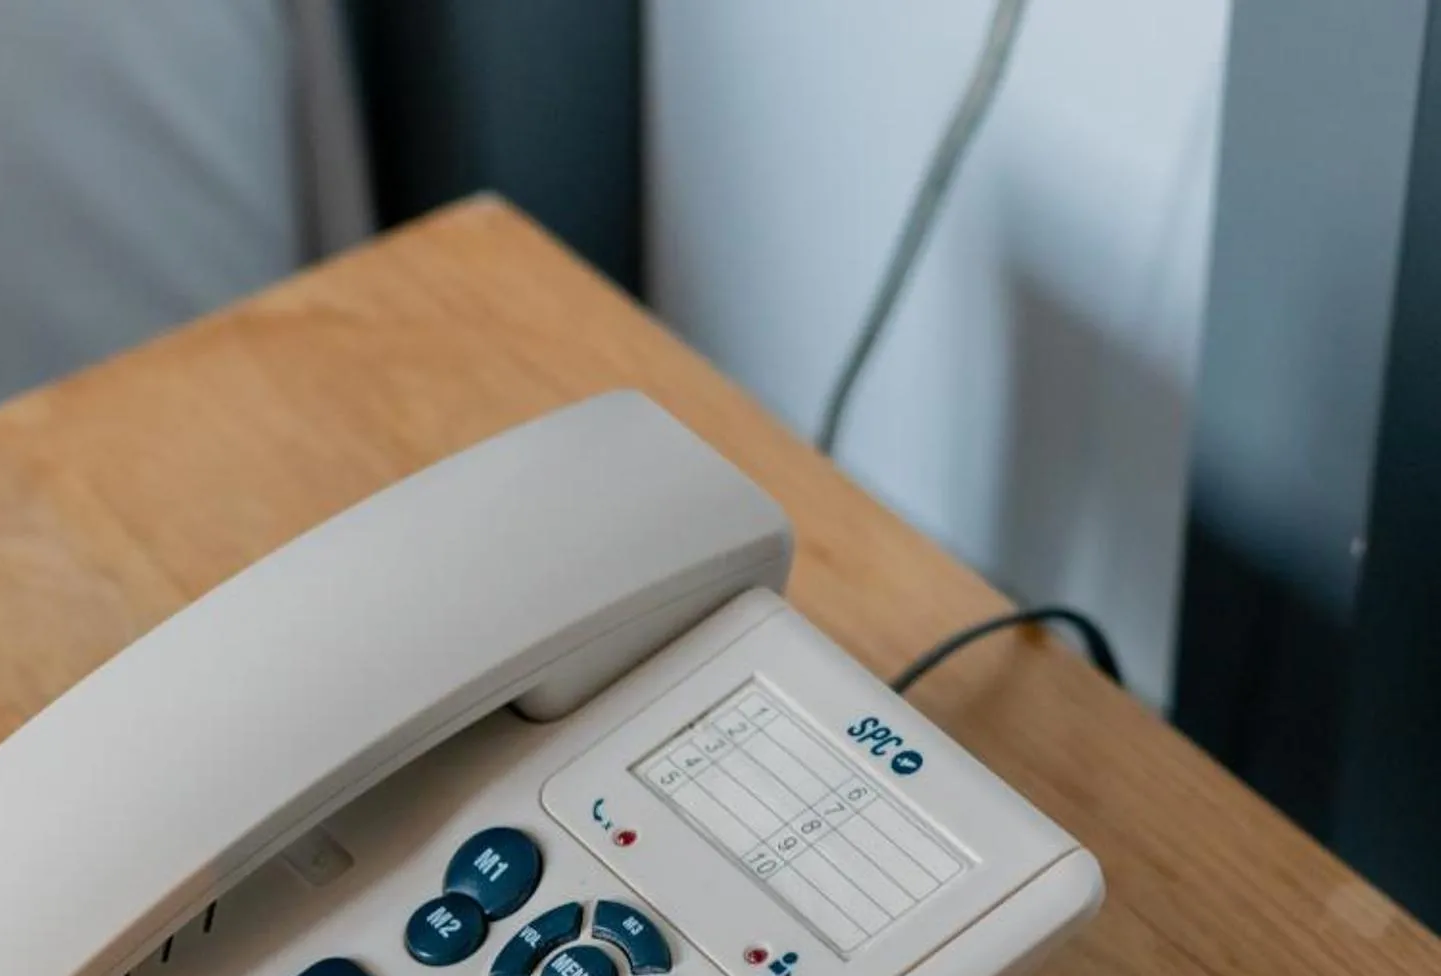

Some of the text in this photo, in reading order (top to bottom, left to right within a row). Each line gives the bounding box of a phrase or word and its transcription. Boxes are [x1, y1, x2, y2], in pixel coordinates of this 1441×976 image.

[754, 707, 770, 717] 1
[727, 722, 748, 737] 2
[847, 717, 903, 756] SPC
[704, 739, 727, 754] 3
[684, 756, 704, 768] 4
[660, 771, 682, 786] 5
[846, 787, 869, 802] 6
[823, 802, 845, 816] 7
[800, 819, 822, 835] 8
[777, 836, 798, 851] 9
[474, 848, 509, 882] M1
[748, 853, 777, 875] 10
[426, 906, 461, 938] M2
[622, 916, 644, 936] M3
[519, 925, 541, 948] VOL
